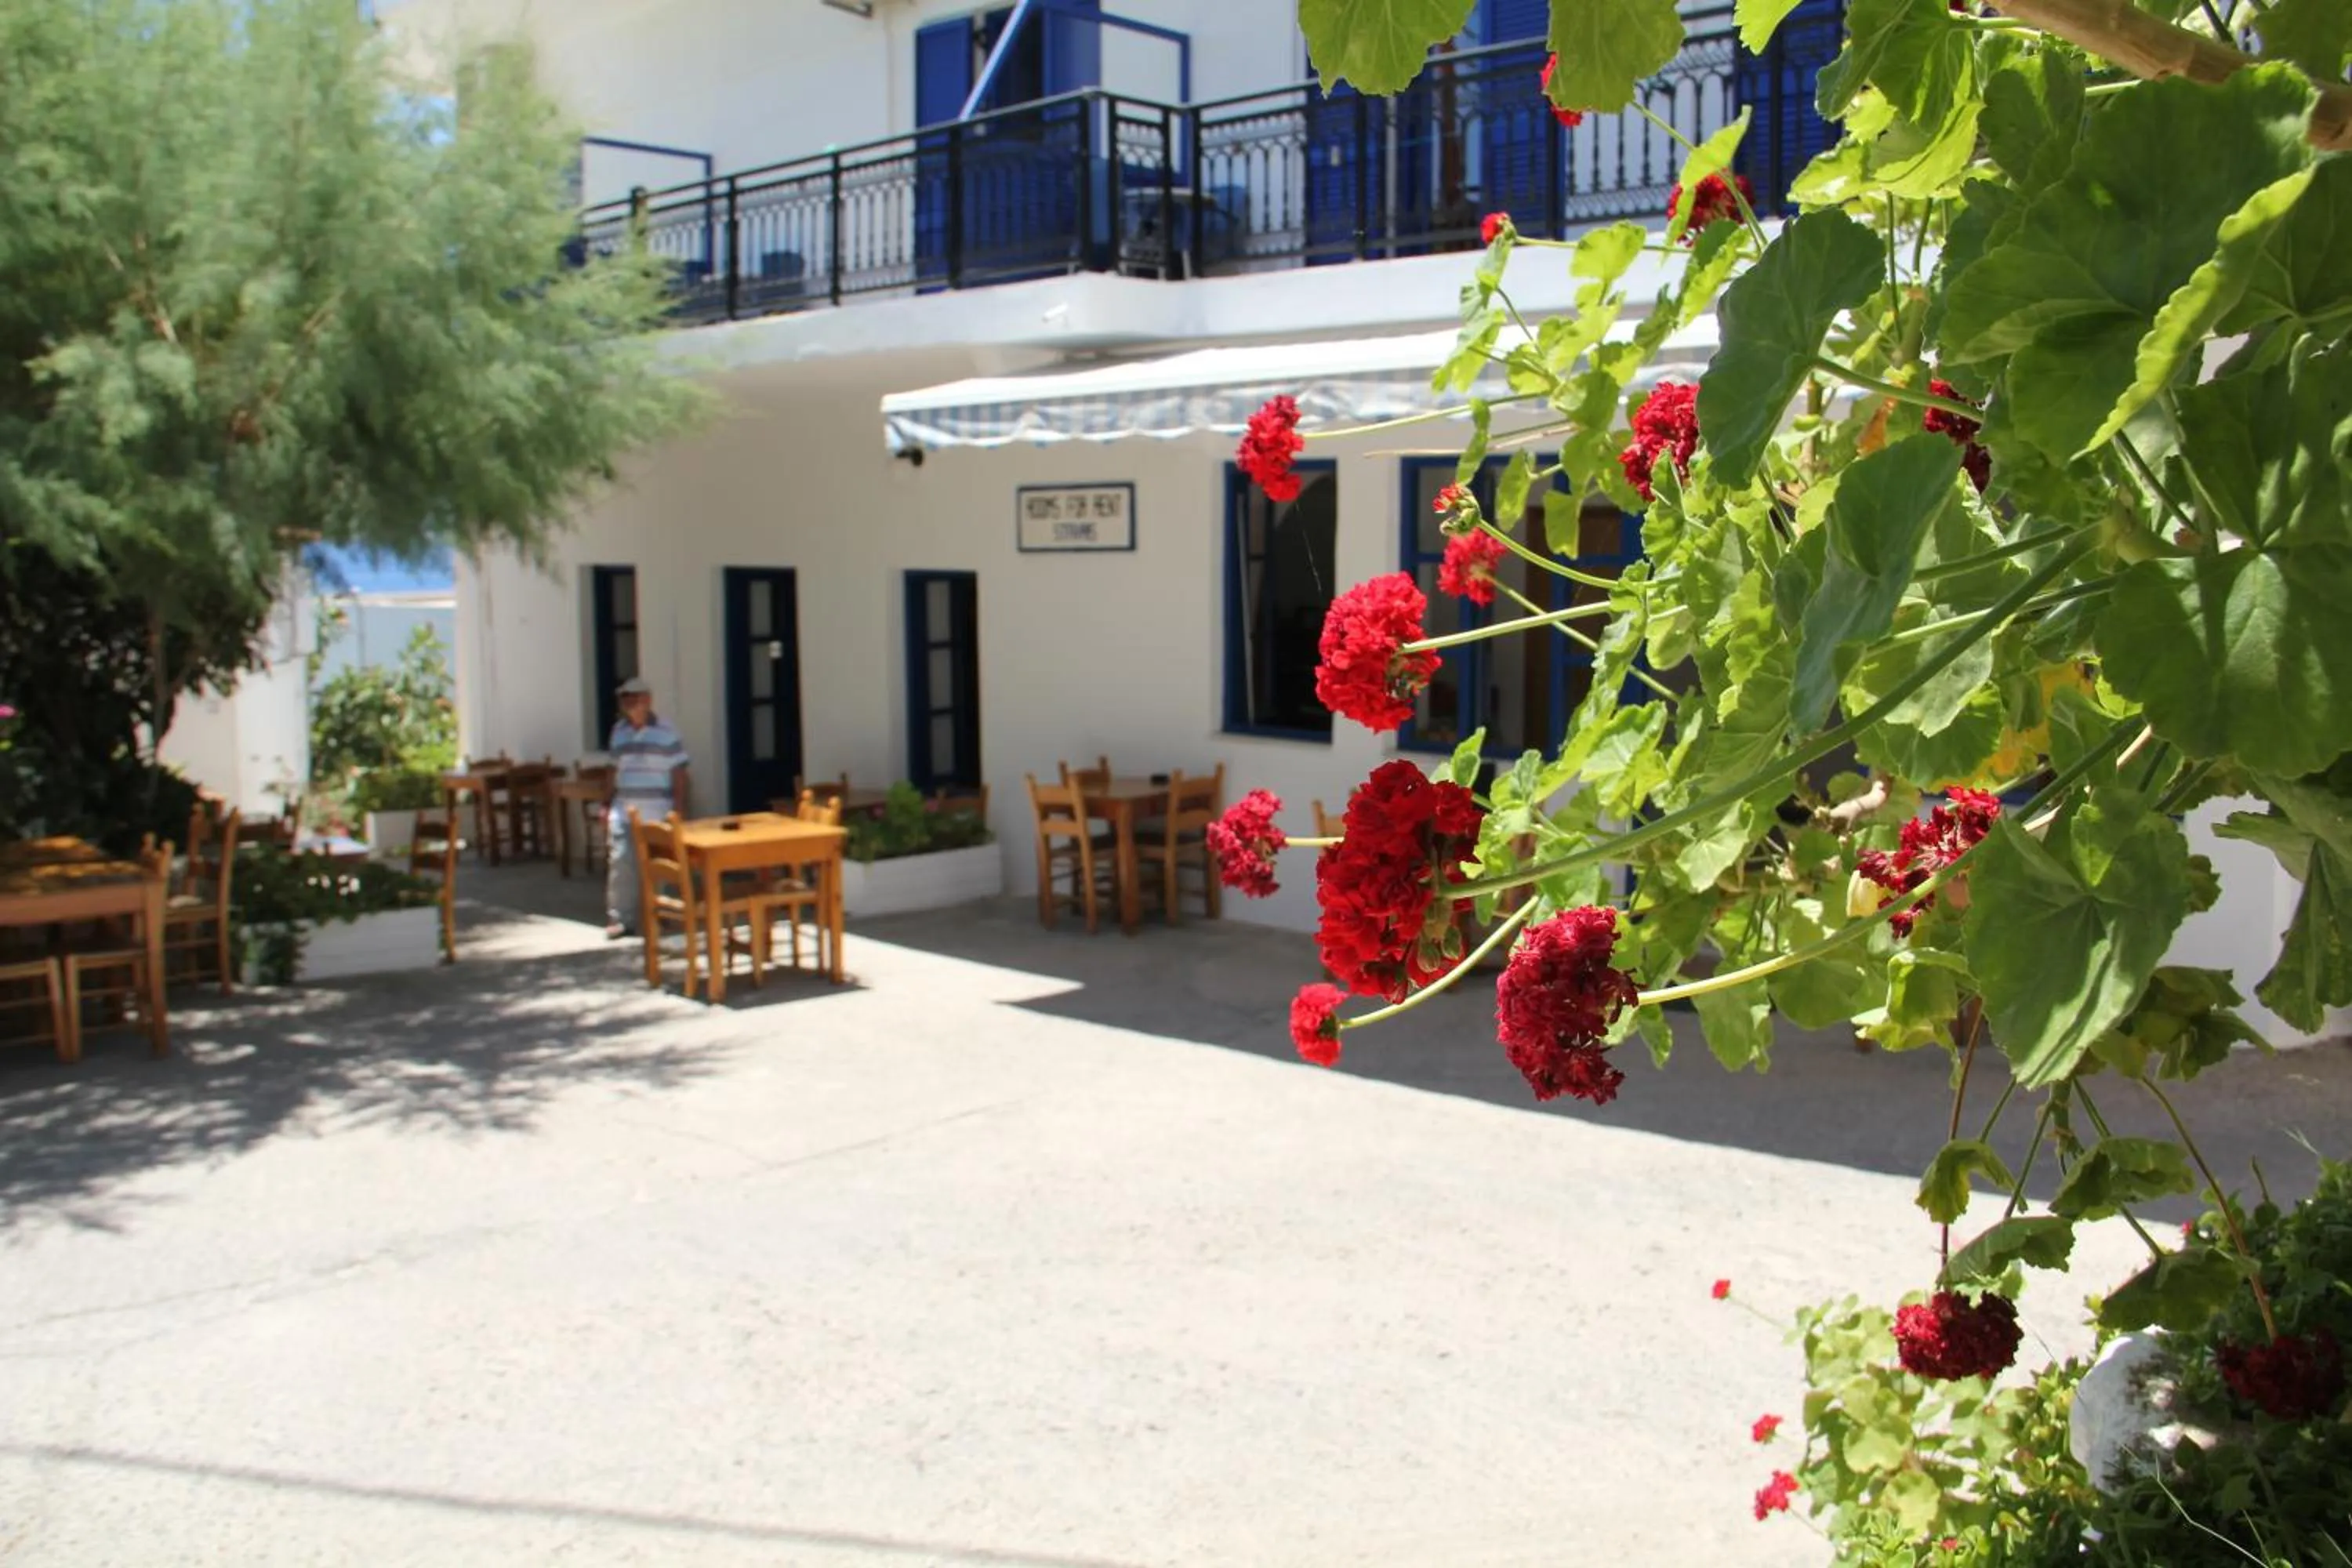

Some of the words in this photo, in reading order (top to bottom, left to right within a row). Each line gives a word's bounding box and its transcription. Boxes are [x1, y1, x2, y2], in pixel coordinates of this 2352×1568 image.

[1026, 495, 1060, 520] ROOMS
[1066, 494, 1087, 519] FOR
[1093, 492, 1121, 517] RENT
